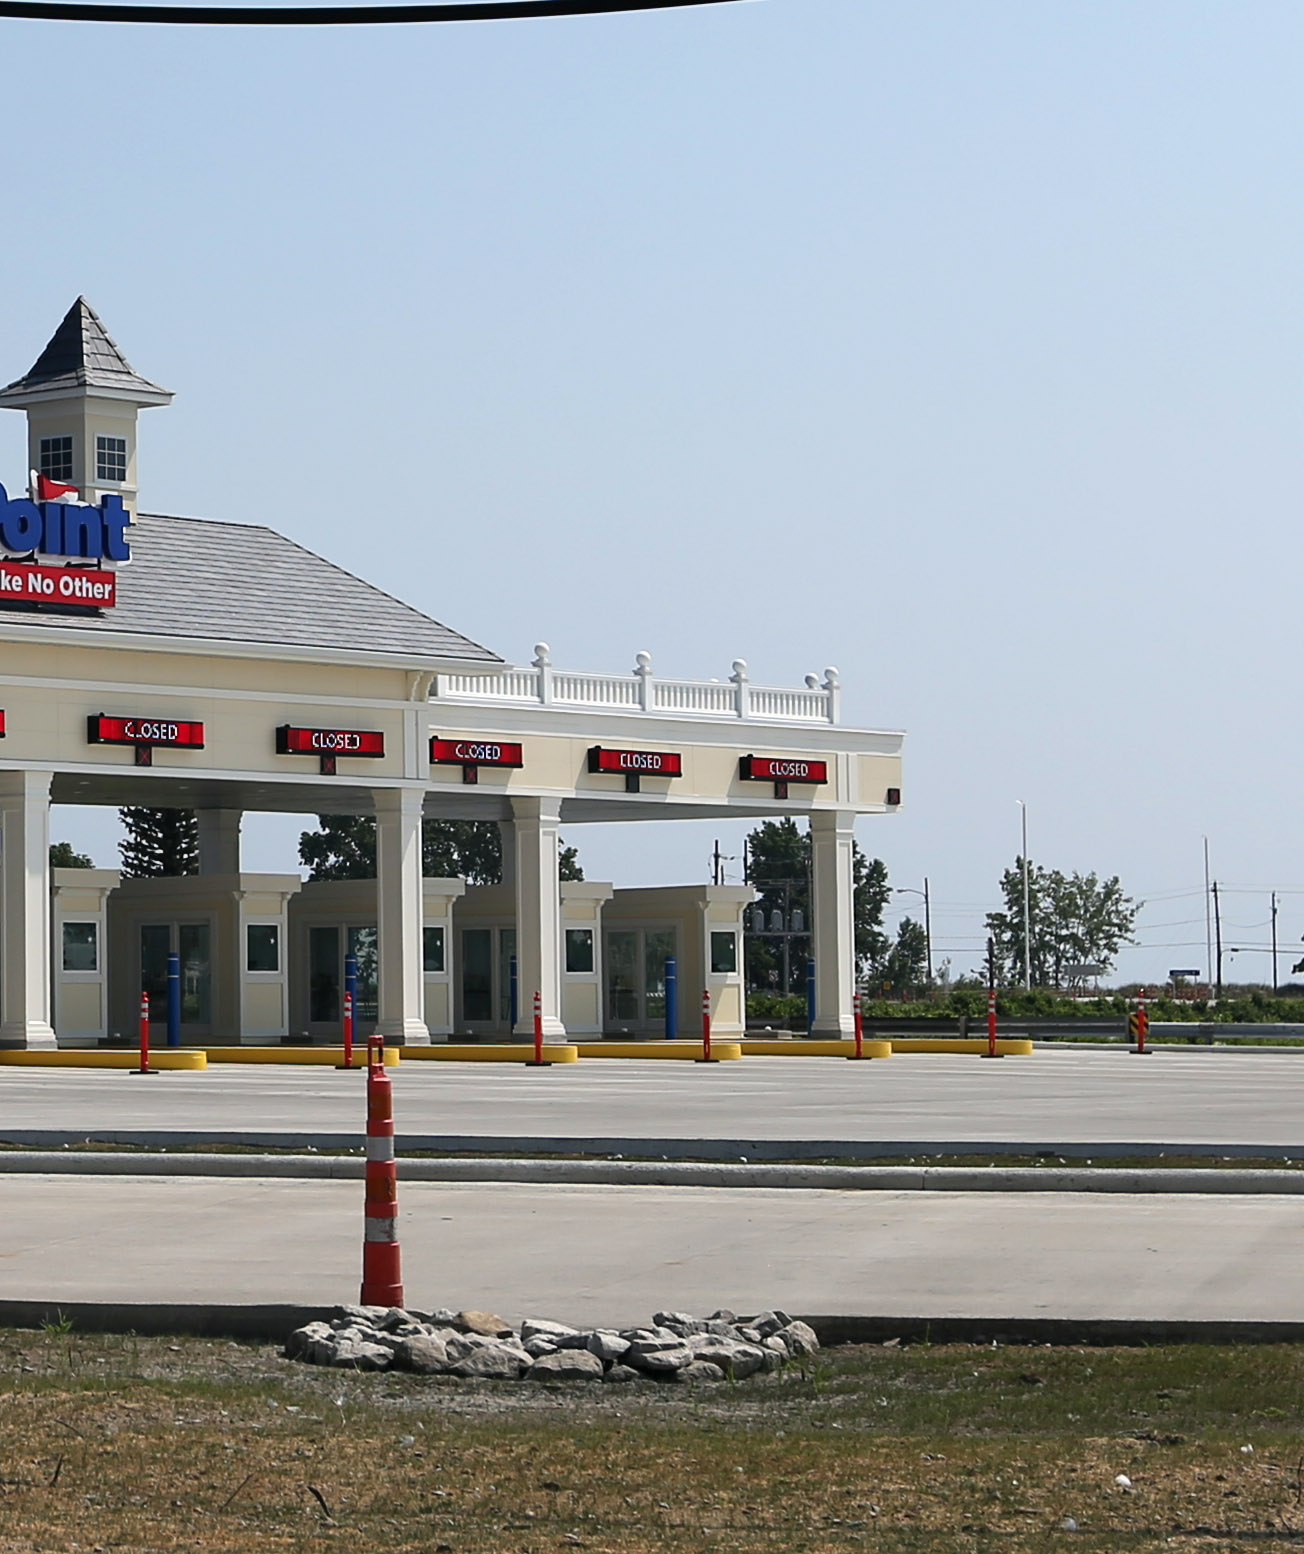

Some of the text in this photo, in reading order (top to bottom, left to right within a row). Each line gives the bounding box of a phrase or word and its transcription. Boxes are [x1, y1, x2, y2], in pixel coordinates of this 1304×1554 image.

[28, 572, 55, 595] No
[59, 576, 113, 600] Other
[312, 732, 360, 750] CLOSED
[455, 743, 501, 760] CLOSED
[620, 753, 662, 769] CLOSED
[769, 761, 809, 777] CLOSED
